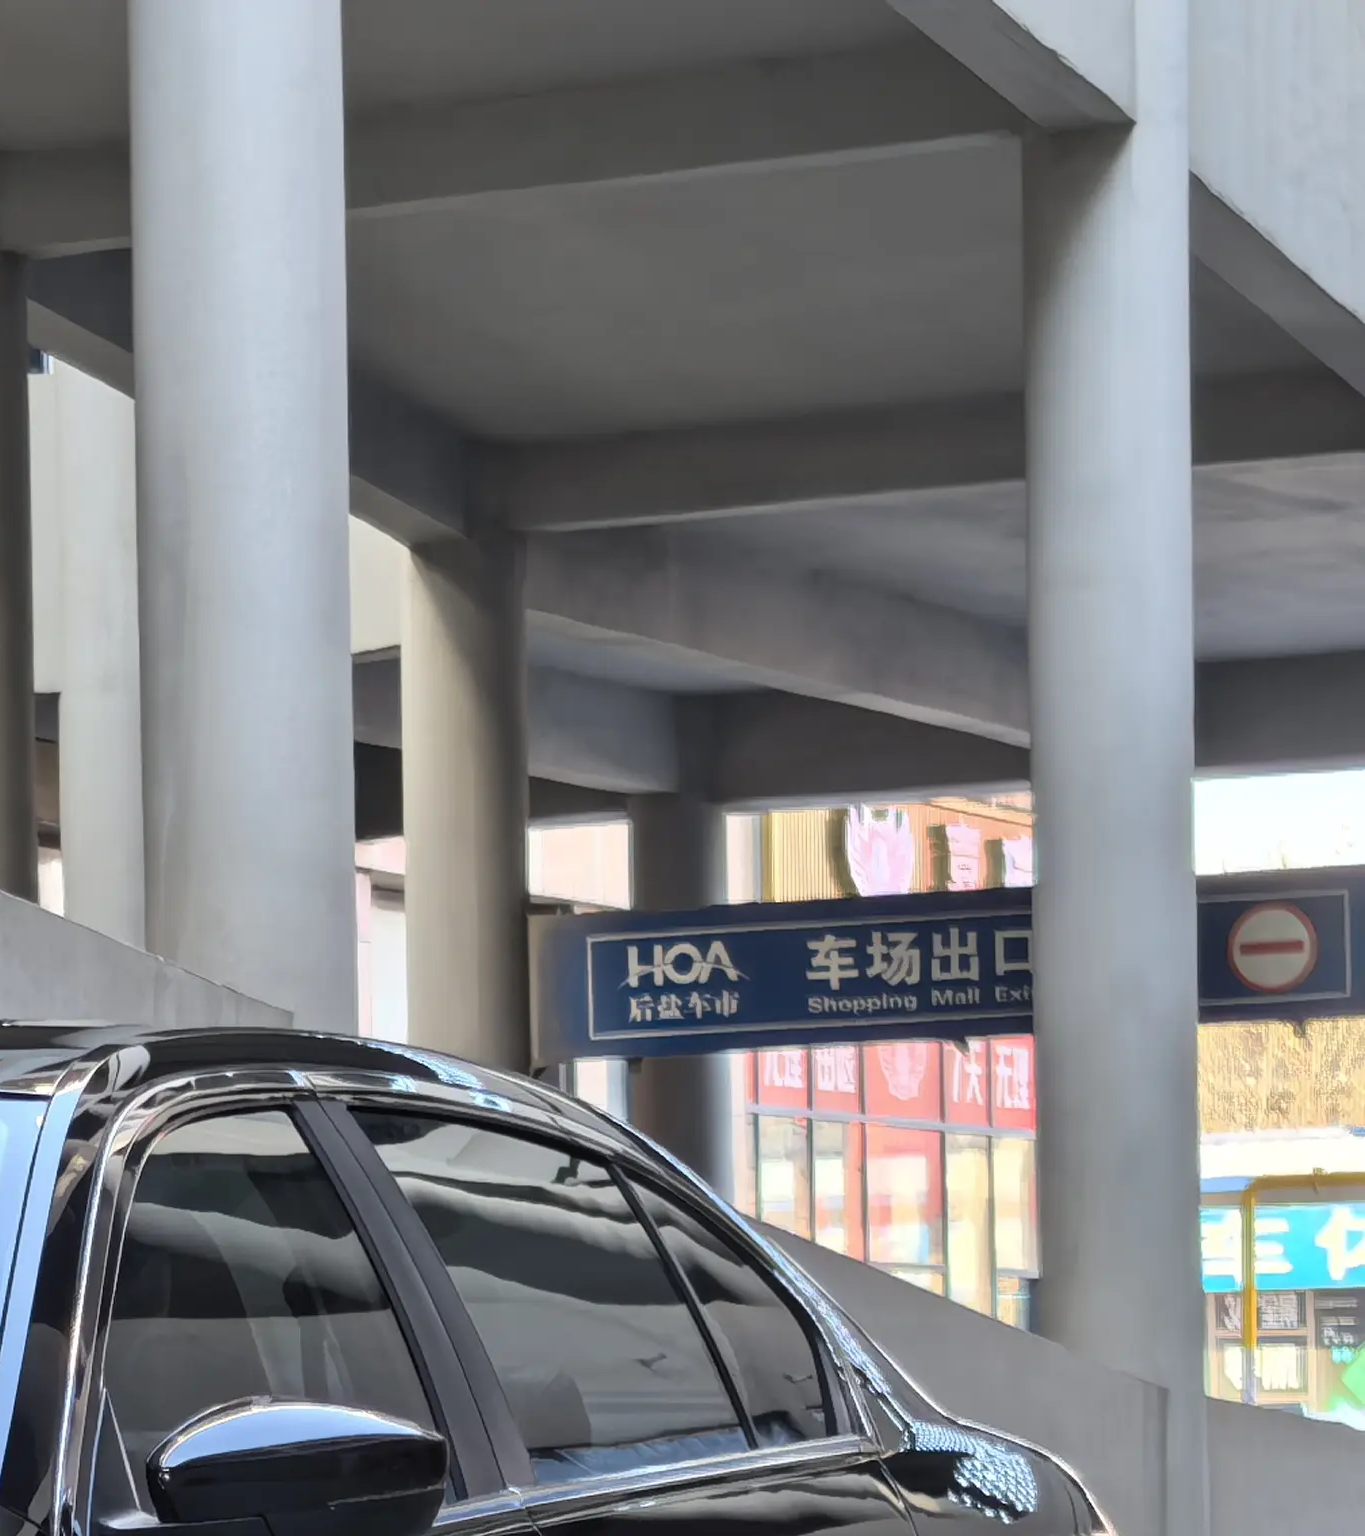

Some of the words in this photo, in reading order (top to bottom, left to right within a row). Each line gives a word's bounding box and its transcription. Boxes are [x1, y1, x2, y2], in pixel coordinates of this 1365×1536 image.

[625, 940, 742, 989] HOA
[805, 926, 1033, 991] 车场出口
[808, 994, 918, 1016] Shopping
[931, 986, 981, 1006] Mall
[994, 984, 1032, 1002] Exi
